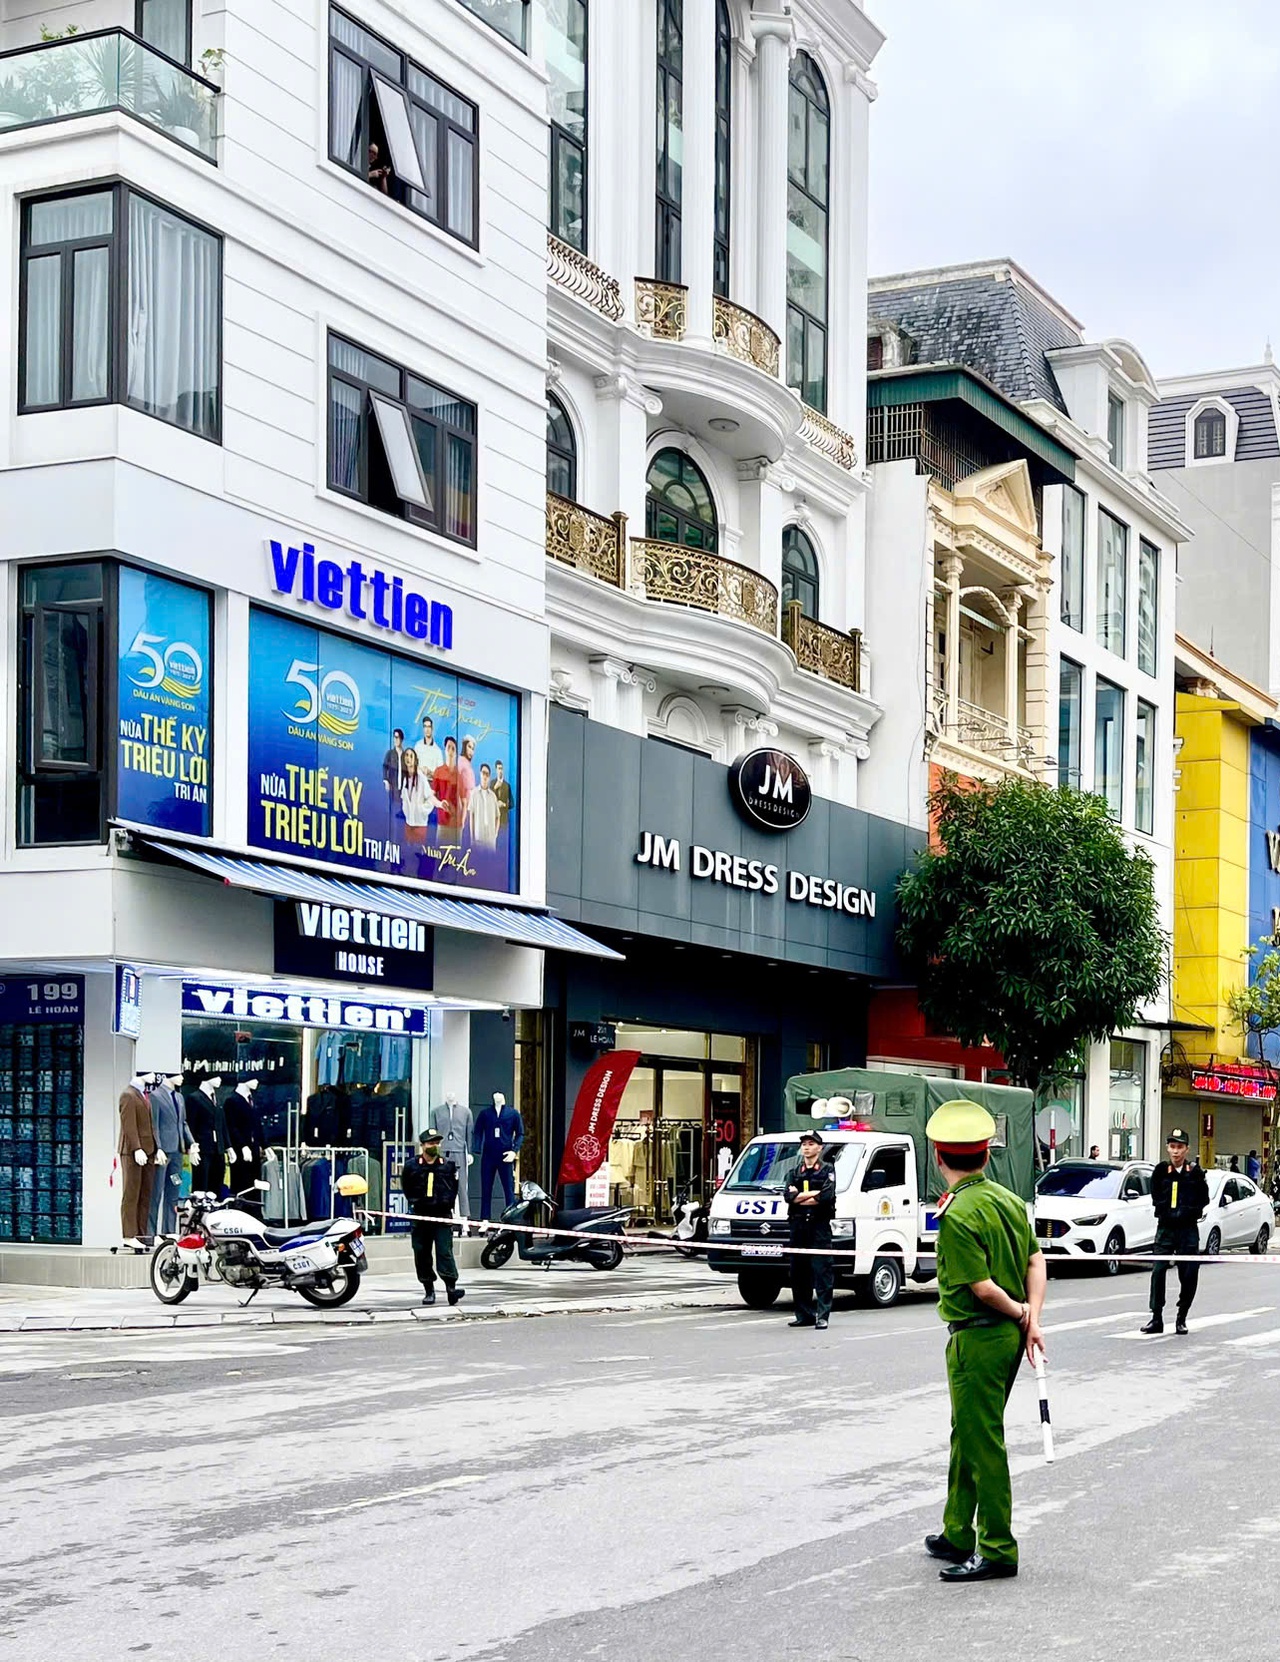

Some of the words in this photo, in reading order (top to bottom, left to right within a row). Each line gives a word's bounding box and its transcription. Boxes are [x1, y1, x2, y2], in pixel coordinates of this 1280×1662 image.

[269, 539, 453, 650] viettien
[120, 739, 176, 780] TRIỆU
[179, 751, 208, 786] LỜI
[174, 781, 190, 801] TRI
[285, 763, 328, 809] THẾ
[758, 764, 793, 804] JM
[748, 796, 772, 812] DRESS
[773, 804, 800, 819] DESIGN
[260, 800, 326, 850] TRIỆU
[330, 813, 364, 857] LỜI
[364, 838, 381, 861] TRI
[637, 831, 680, 871] JM
[692, 845, 779, 895] DRESS
[789, 870, 877, 918] DESIGN
[299, 902, 426, 952] viettien
[338, 951, 385, 977] HOUSE
[27, 982, 78, 1000] 199
[29, 1005, 42, 1014] LÊ
[46, 1005, 78, 1014] HOÀN
[197, 988, 405, 1031] viettien
[573, 1029, 585, 1037] JM
[155, 1073, 167, 1084] 99
[597, 1070, 613, 1098] DESIGN
[590, 1098, 602, 1122] DRESS
[588, 1122, 597, 1134] JM
[736, 1200, 783, 1215] CST
